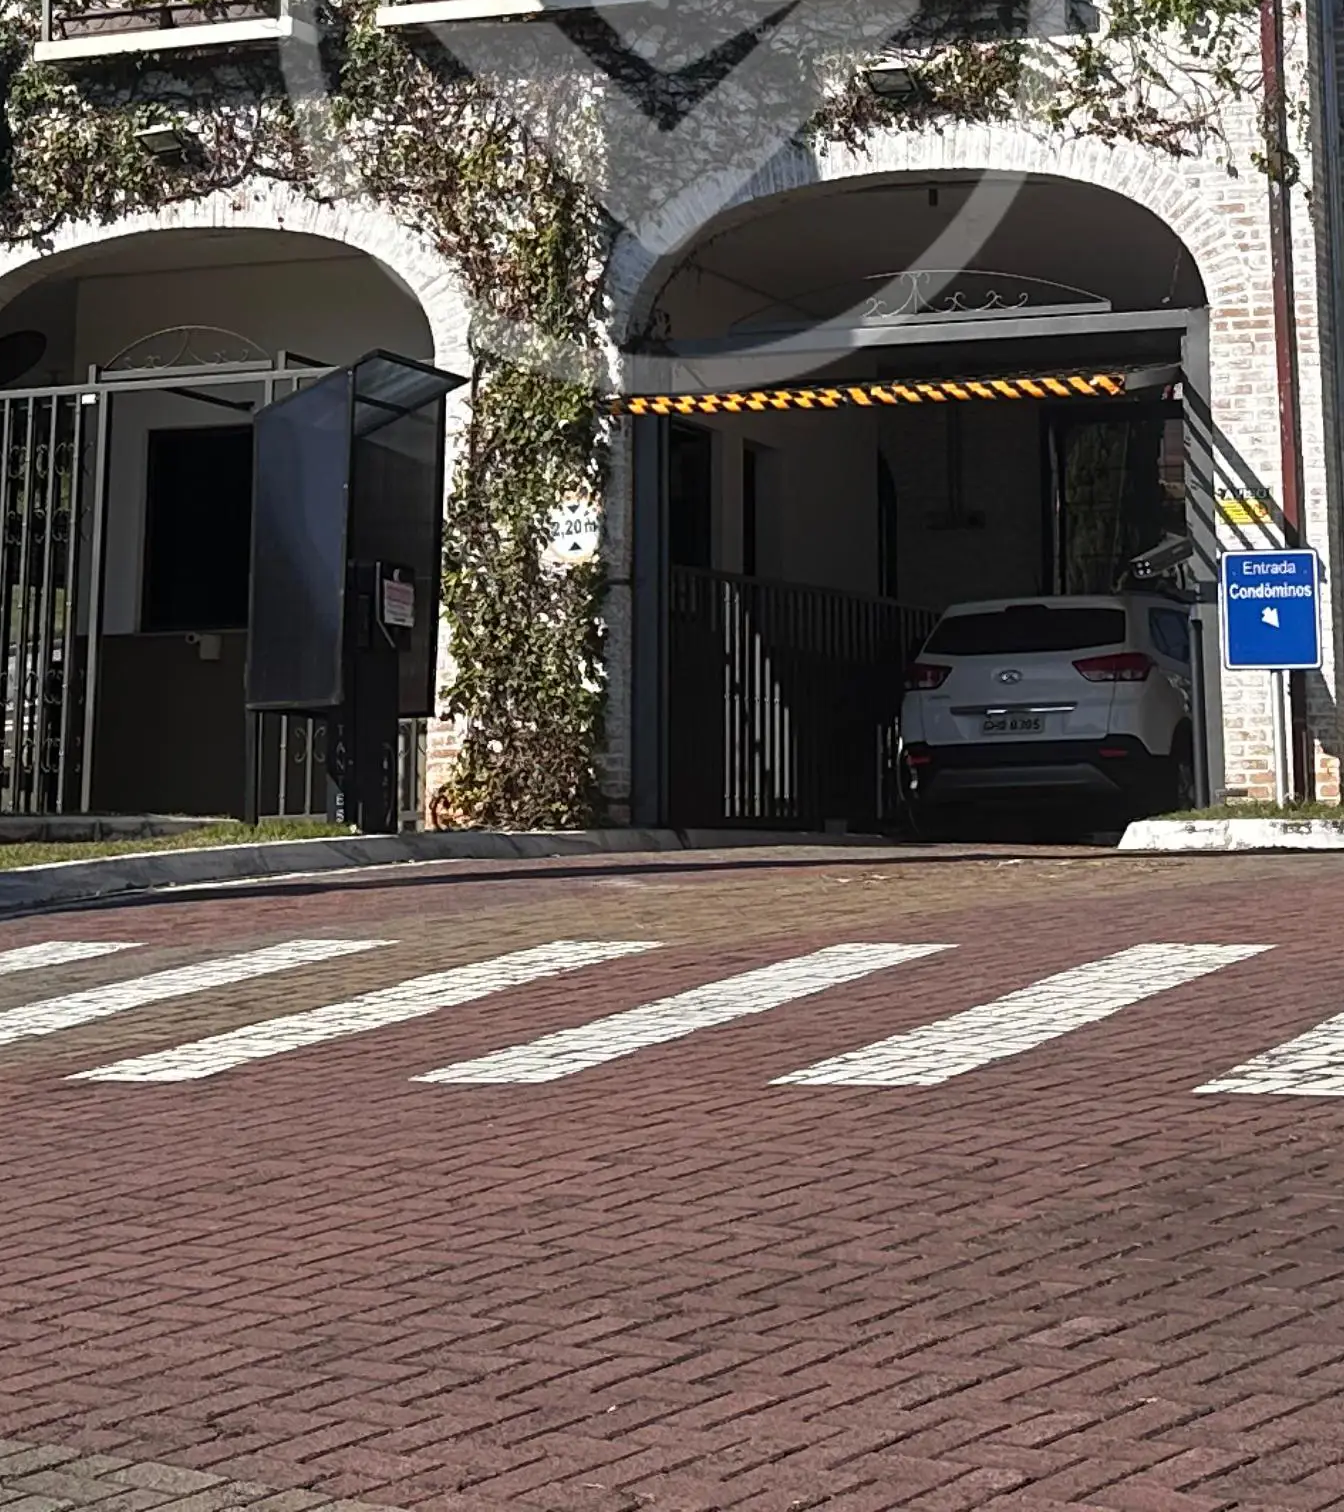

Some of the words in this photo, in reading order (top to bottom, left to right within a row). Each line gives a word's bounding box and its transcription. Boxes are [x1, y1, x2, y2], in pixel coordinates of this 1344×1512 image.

[551, 519, 582, 538] 2,20
[1242, 561, 1296, 575] Entrada
[1229, 582, 1312, 599] Condôminos
